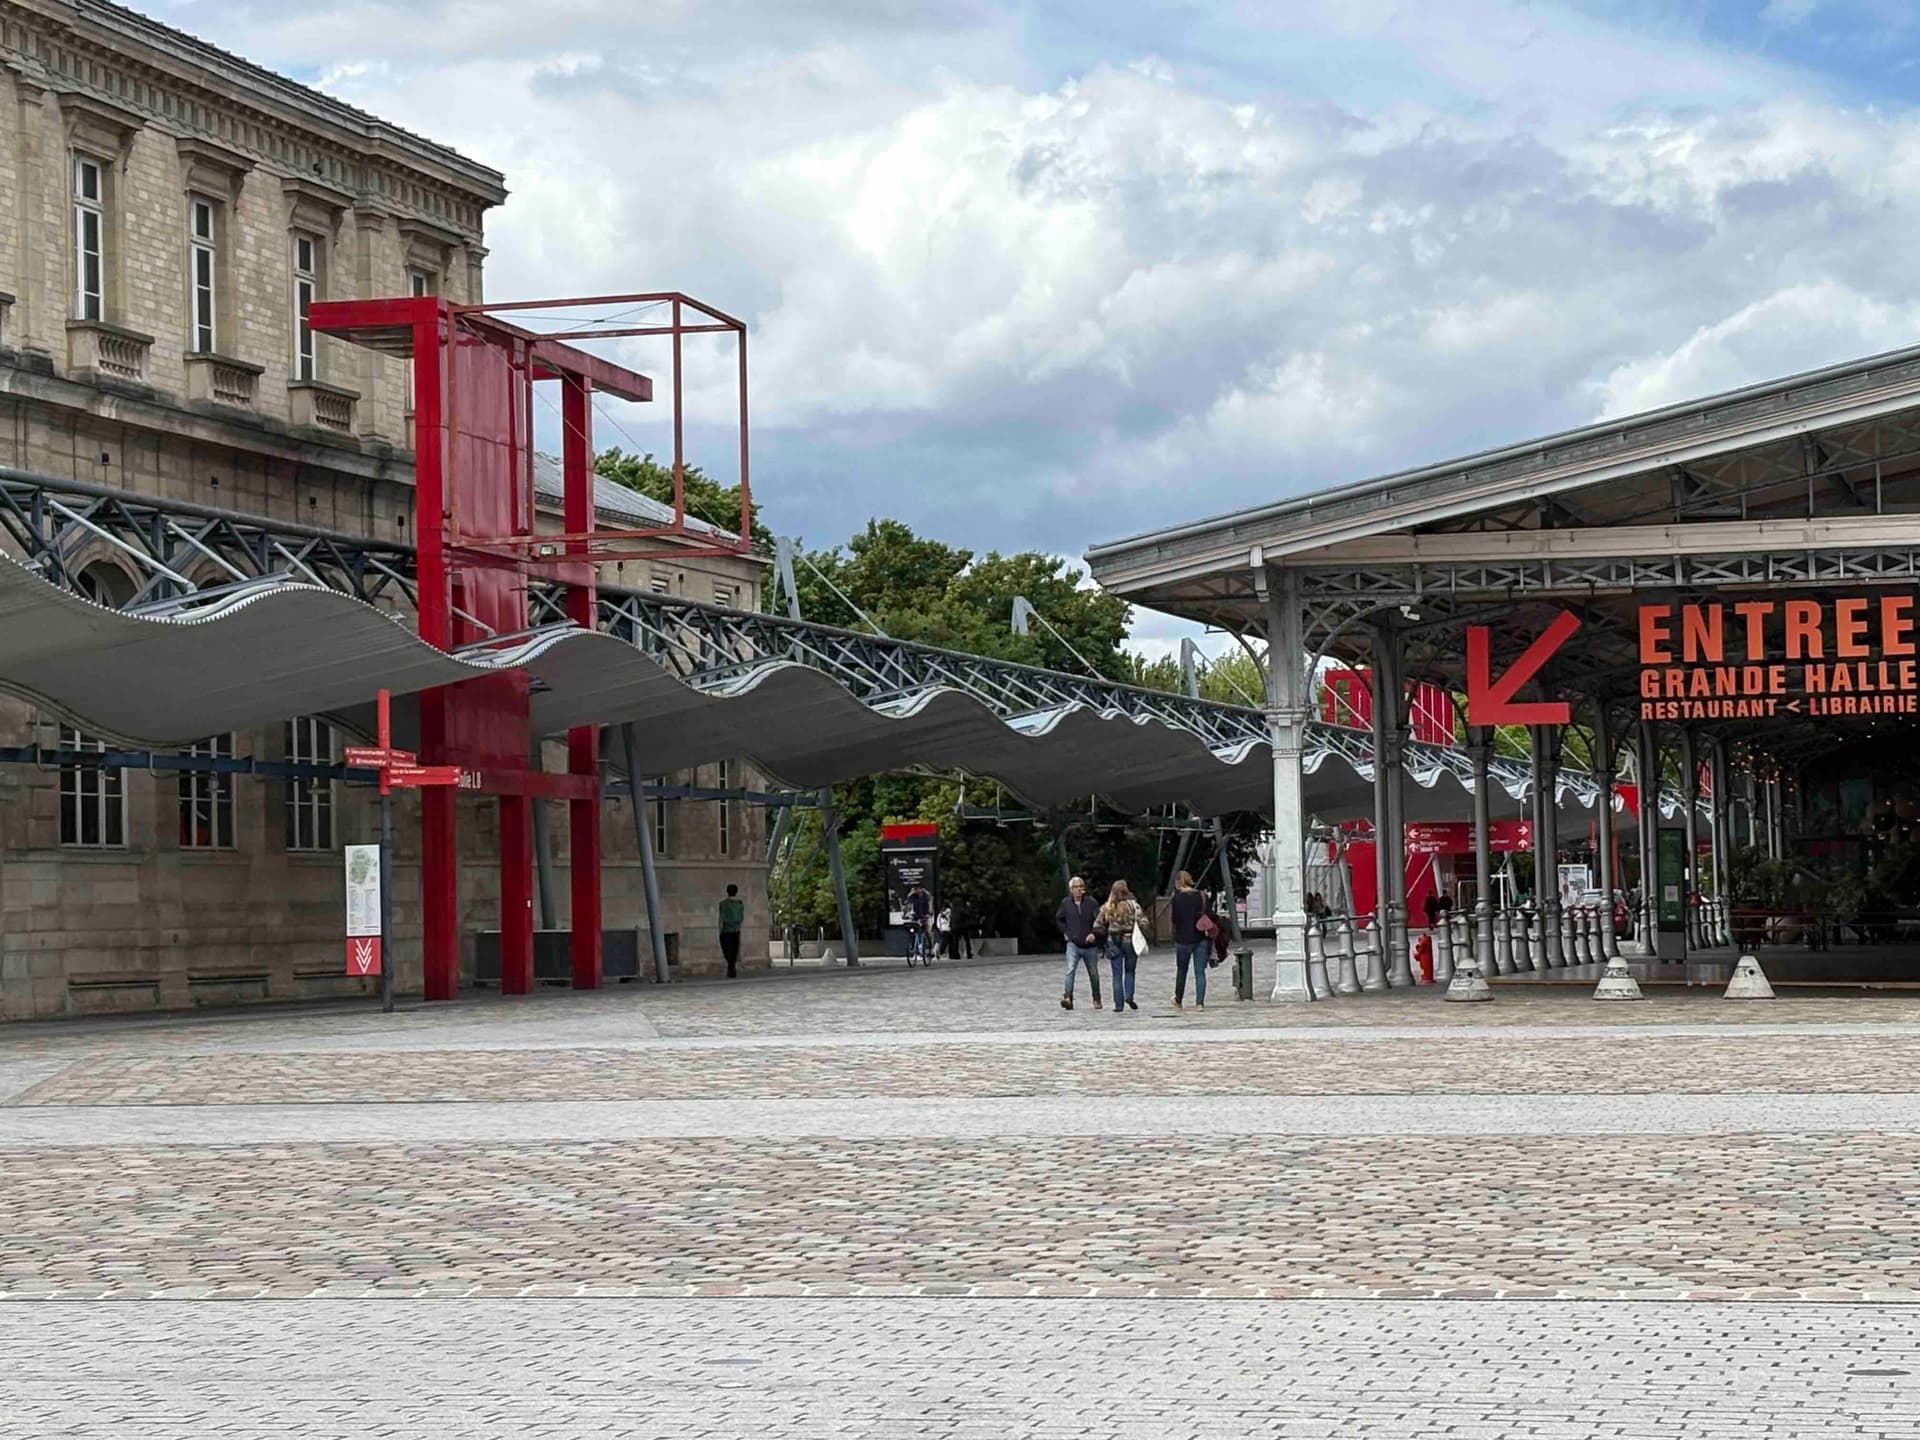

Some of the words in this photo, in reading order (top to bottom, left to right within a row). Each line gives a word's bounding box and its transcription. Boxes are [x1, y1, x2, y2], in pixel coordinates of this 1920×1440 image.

[1638, 596, 1916, 664] ENTREE
[1640, 665, 1787, 698] GRANDE
[1804, 660, 1918, 693] HALLE
[1640, 698, 1778, 720] RESTAURANT
[1809, 694, 1918, 716] LIBRAIRIE
